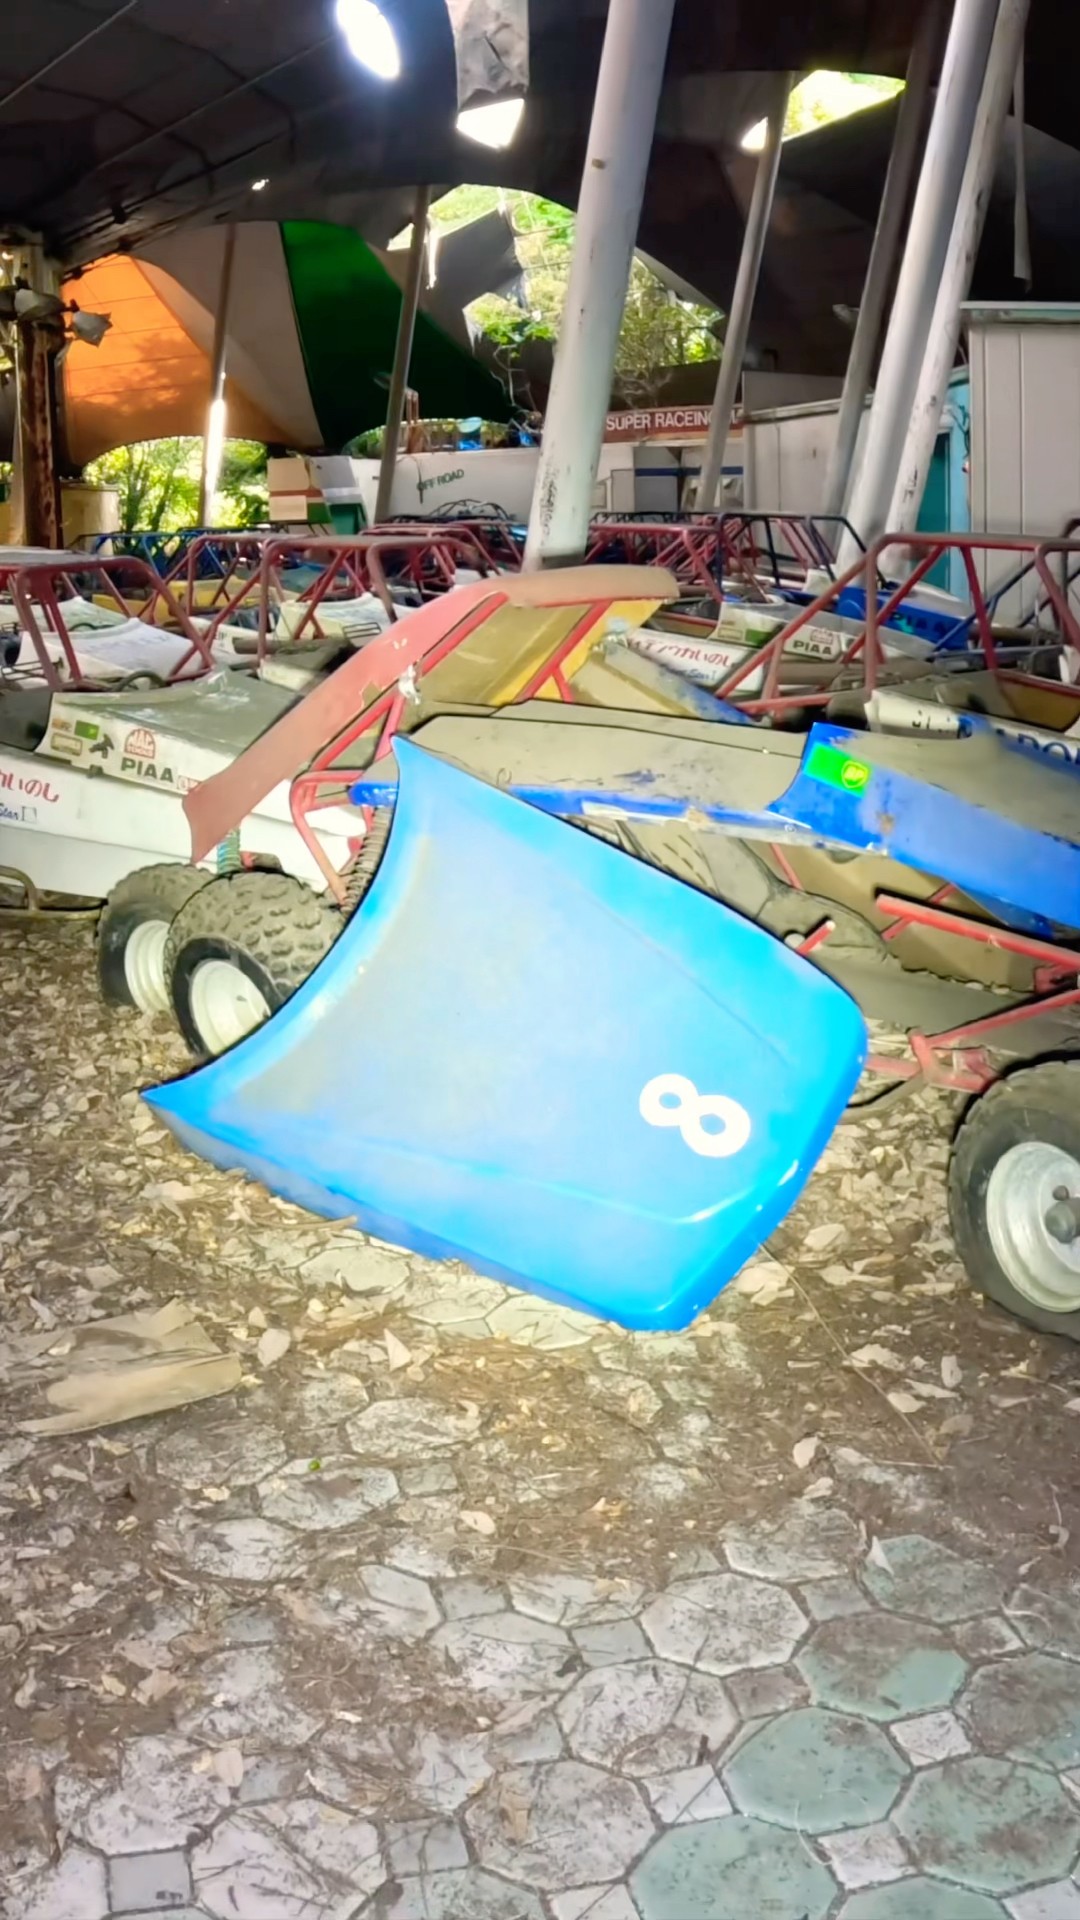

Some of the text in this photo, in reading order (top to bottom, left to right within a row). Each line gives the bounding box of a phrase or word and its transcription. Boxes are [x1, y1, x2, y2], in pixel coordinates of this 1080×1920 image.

[606, 413, 651, 431] SUPER
[437, 468, 465, 487] ROAD
[793, 640, 832, 656] PIAA
[121, 757, 174, 784] PIAA
[638, 1073, 752, 1158] 8
